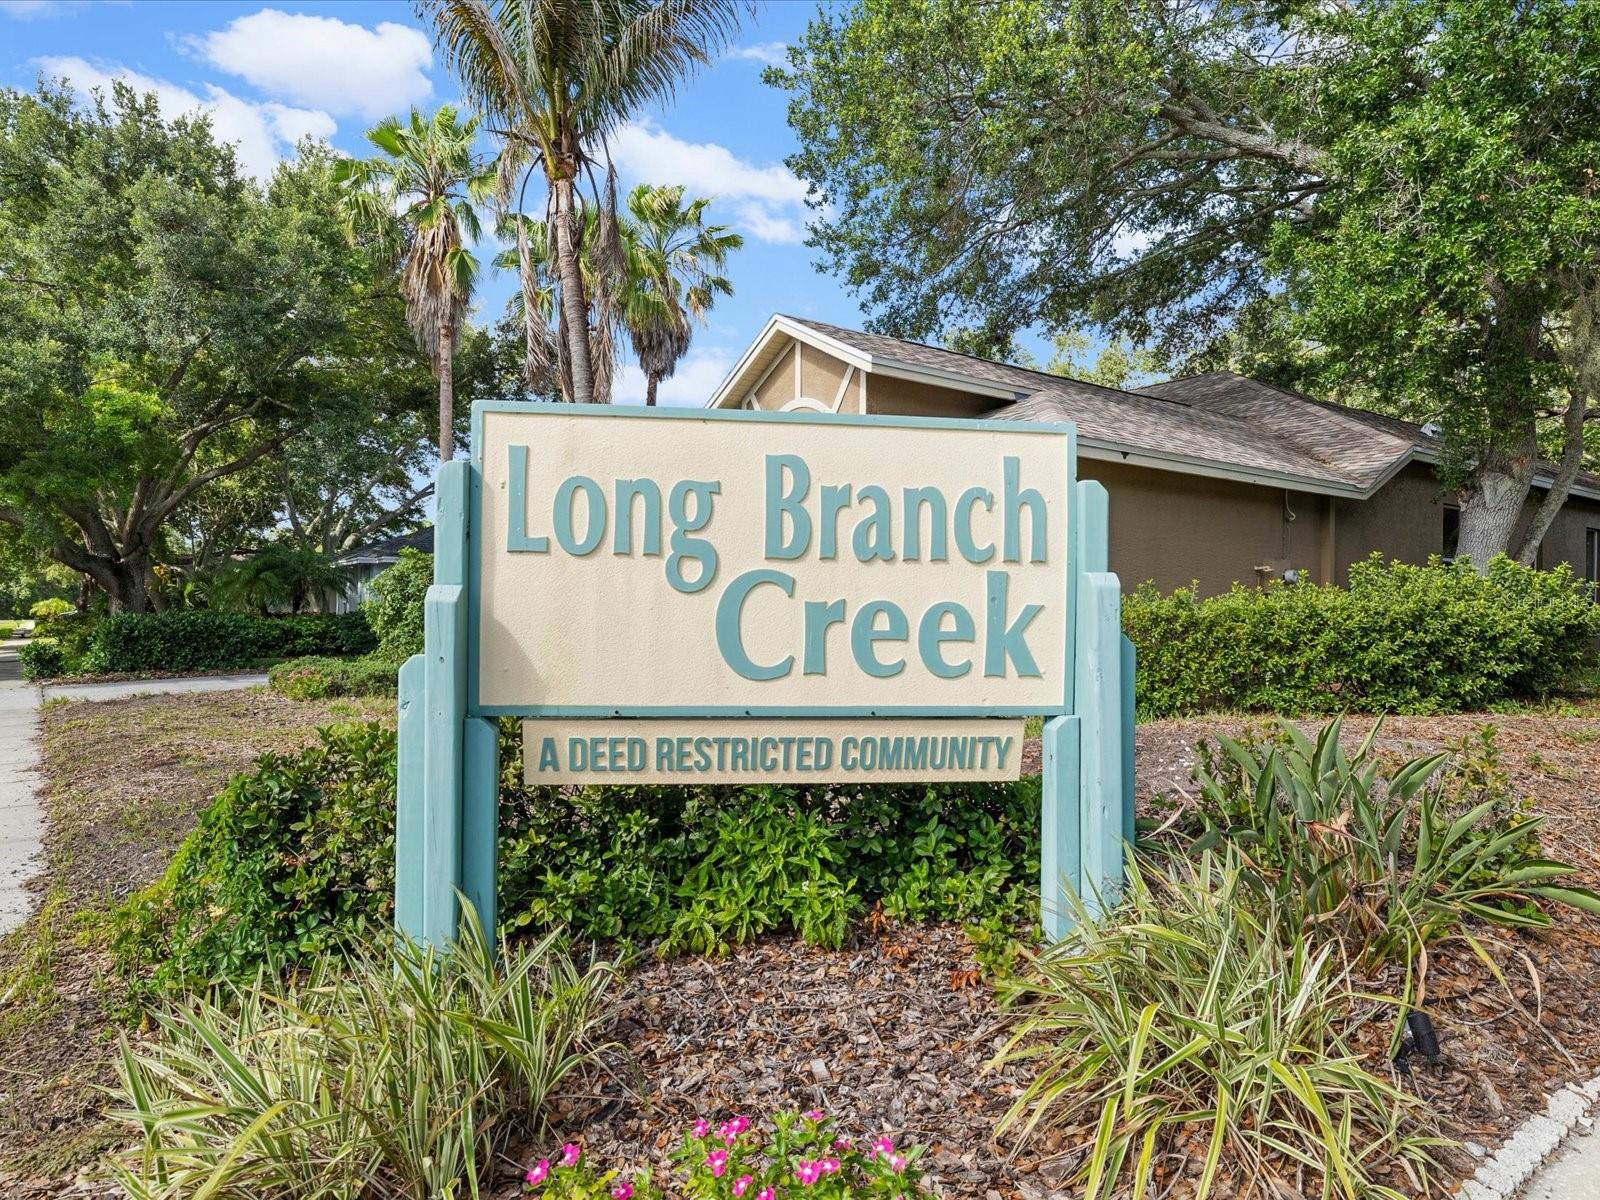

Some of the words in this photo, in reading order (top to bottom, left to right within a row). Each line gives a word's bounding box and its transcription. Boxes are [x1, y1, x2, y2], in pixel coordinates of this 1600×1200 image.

[507, 445, 721, 593] Long
[765, 454, 1048, 564] Branch
[715, 568, 1046, 681] Creek
[538, 737, 560, 772] A
[569, 737, 648, 772] DEED
[656, 737, 833, 771] RESTRICTED
[840, 736, 1014, 771] COMMUNITY
